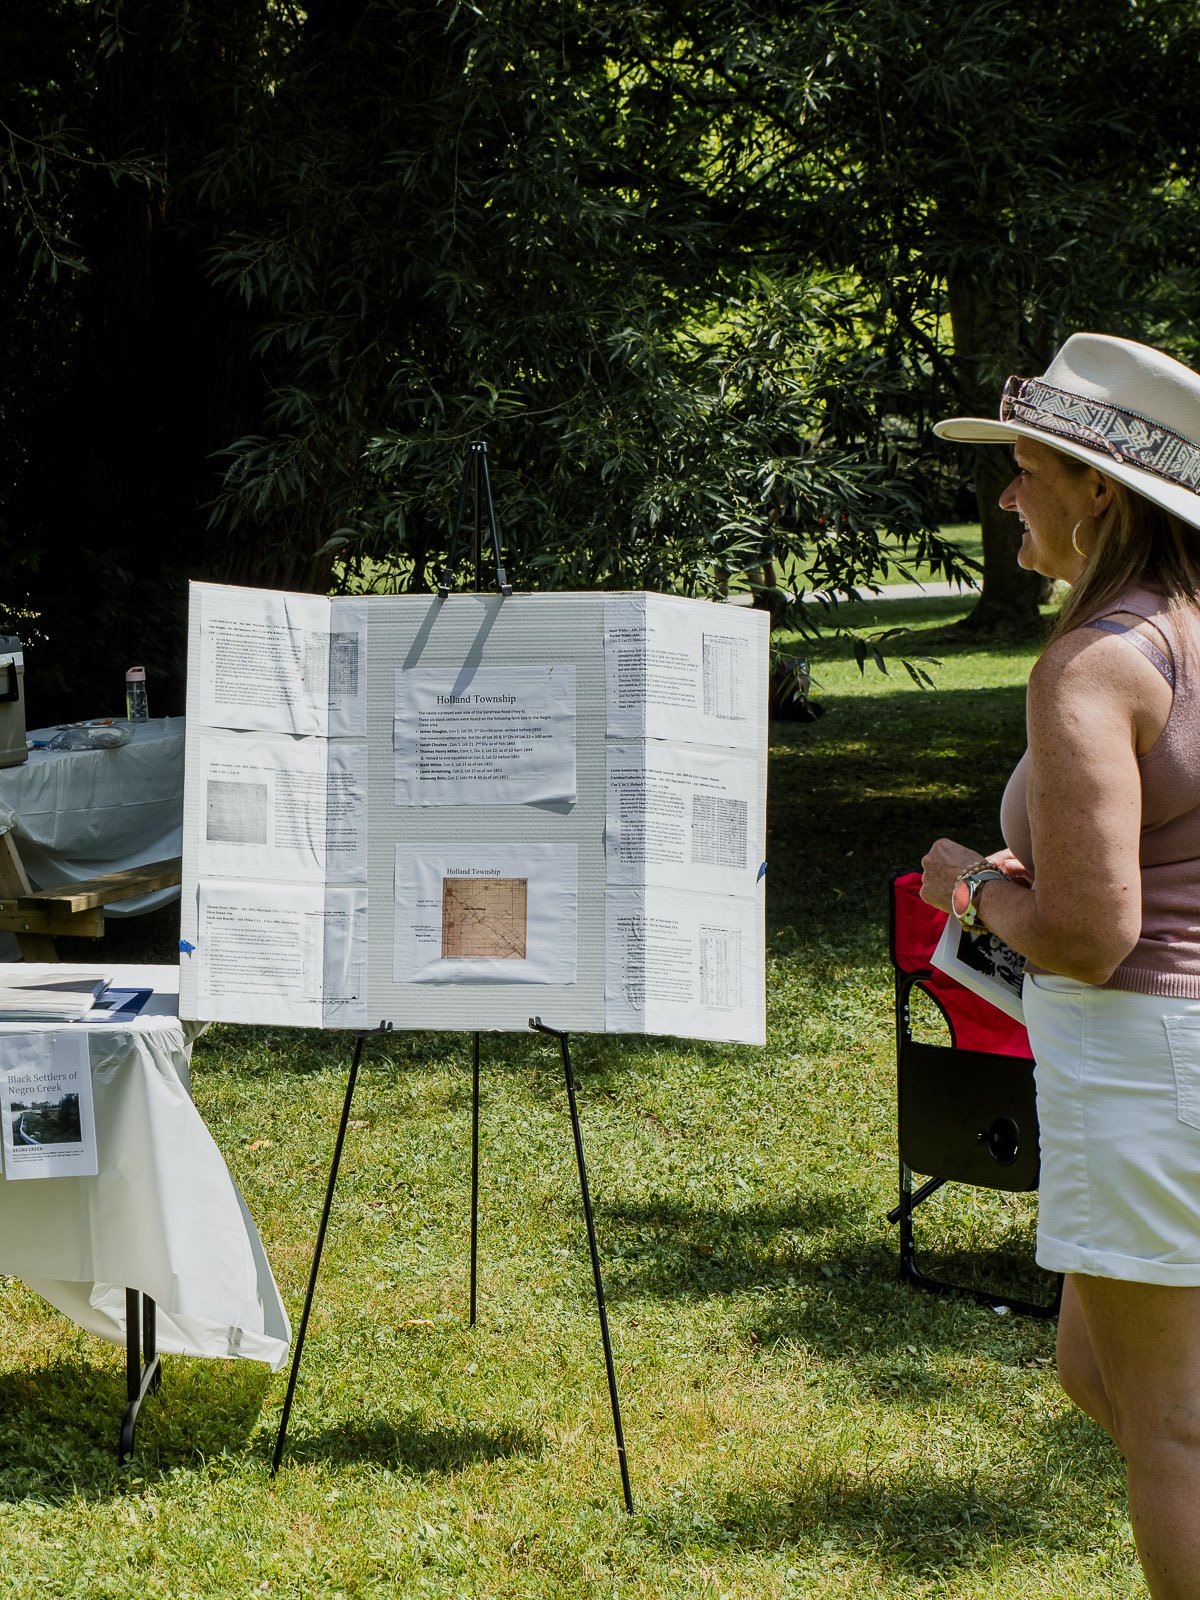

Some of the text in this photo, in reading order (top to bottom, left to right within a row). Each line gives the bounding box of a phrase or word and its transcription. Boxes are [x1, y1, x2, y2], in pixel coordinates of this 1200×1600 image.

[436, 694, 516, 704] Holland Township
[8, 1071, 78, 1084] Black Settlers of
[8, 1084, 63, 1096] Negro Creek
